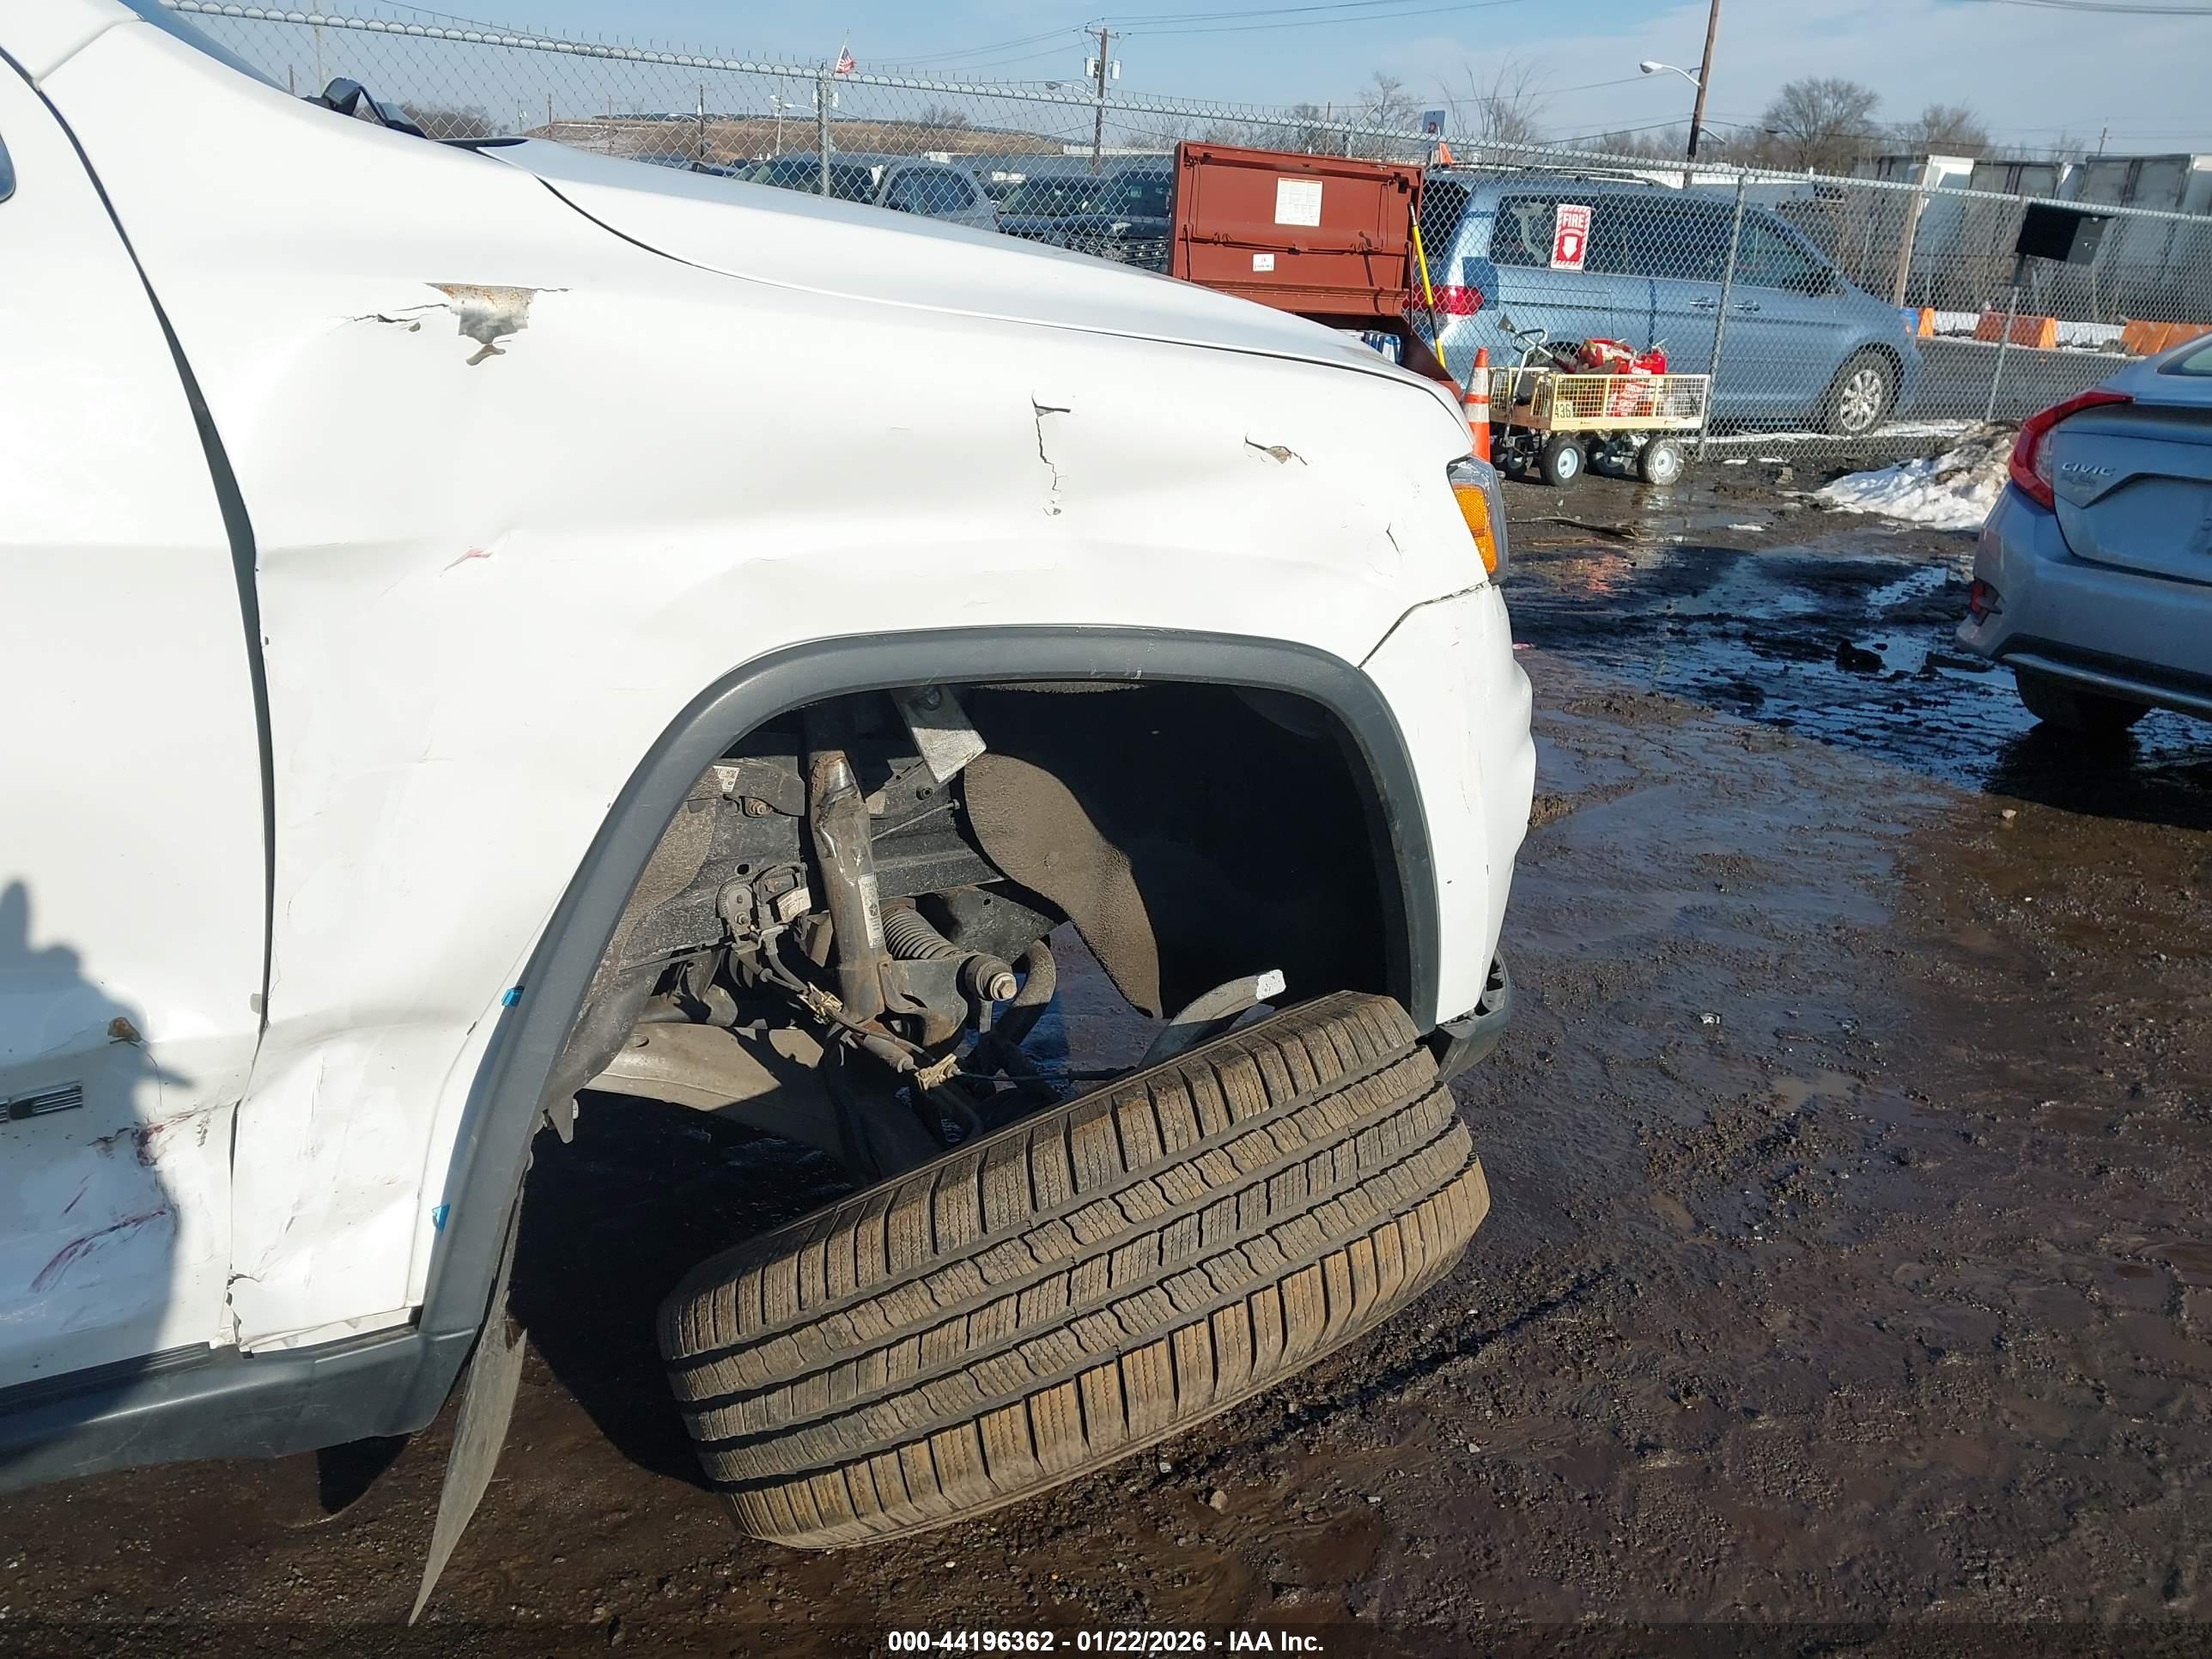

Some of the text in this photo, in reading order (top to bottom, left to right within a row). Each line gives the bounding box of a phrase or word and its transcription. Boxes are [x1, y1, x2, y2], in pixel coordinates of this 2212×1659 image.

[1562, 212, 1586, 229] FIRE
[1554, 403, 1571, 418] A36
[2062, 463, 2116, 477] CIVIC
